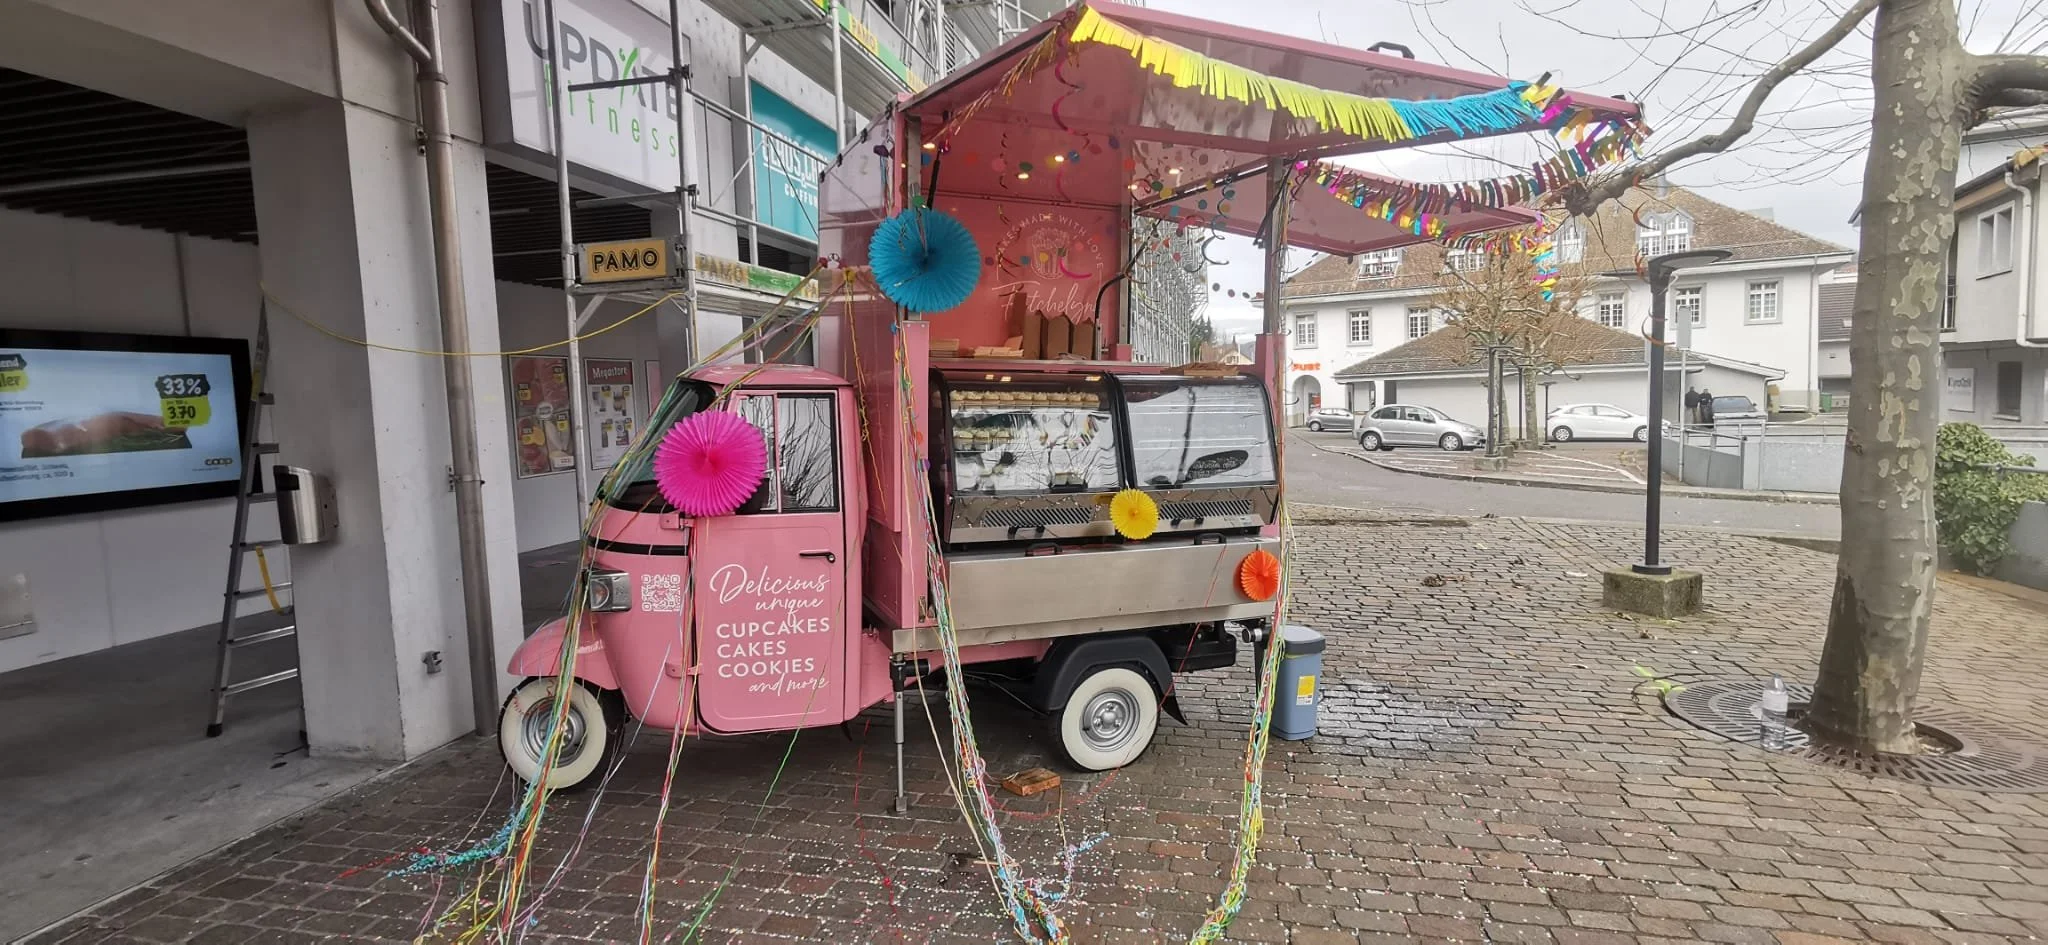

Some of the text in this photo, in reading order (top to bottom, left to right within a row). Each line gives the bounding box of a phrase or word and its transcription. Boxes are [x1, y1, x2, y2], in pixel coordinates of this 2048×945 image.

[522, 0, 678, 122] UPDATE
[1059, 214, 1087, 238] WITH
[1086, 238, 1105, 269] LOVE
[593, 247, 658, 273] PAMO
[162, 377, 202, 395] 33%
[167, 405, 196, 419] 3.70
[709, 564, 830, 604] Delicious
[755, 597, 824, 627] unique
[716, 617, 830, 639] CUPCAKES
[717, 640, 786, 658] CAKES
[718, 658, 815, 678] COOKIES
[748, 672, 829, 697] and more
